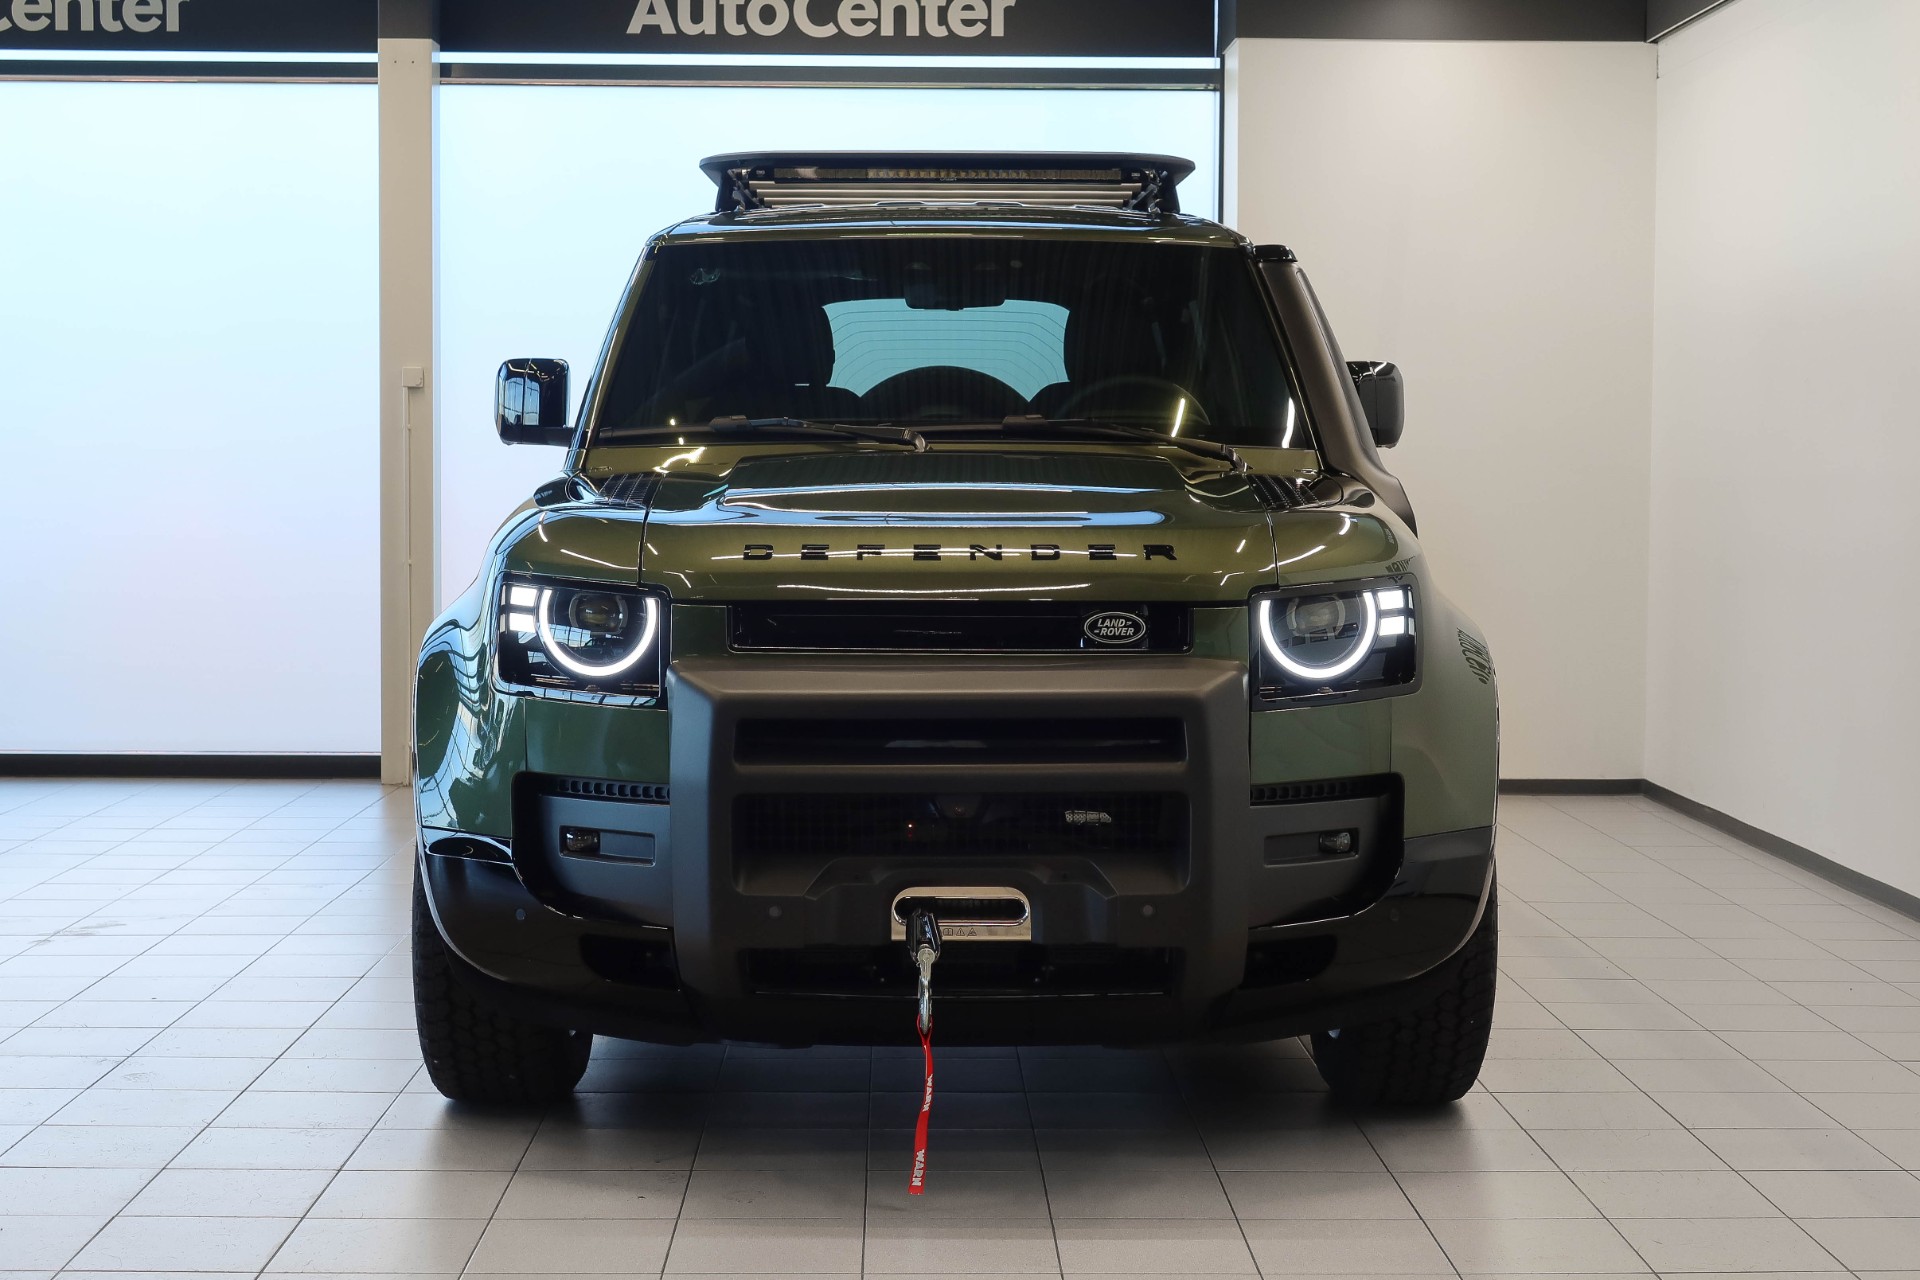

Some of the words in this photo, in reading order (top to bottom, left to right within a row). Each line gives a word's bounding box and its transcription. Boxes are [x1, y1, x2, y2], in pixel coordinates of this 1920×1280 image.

[0, 0, 190, 33] enter
[625, 0, 1017, 38] AutoCenter
[743, 544, 1177, 561] DEFENDER
[922, 1073, 933, 1112] WARN
[912, 1149, 925, 1186] WARN
